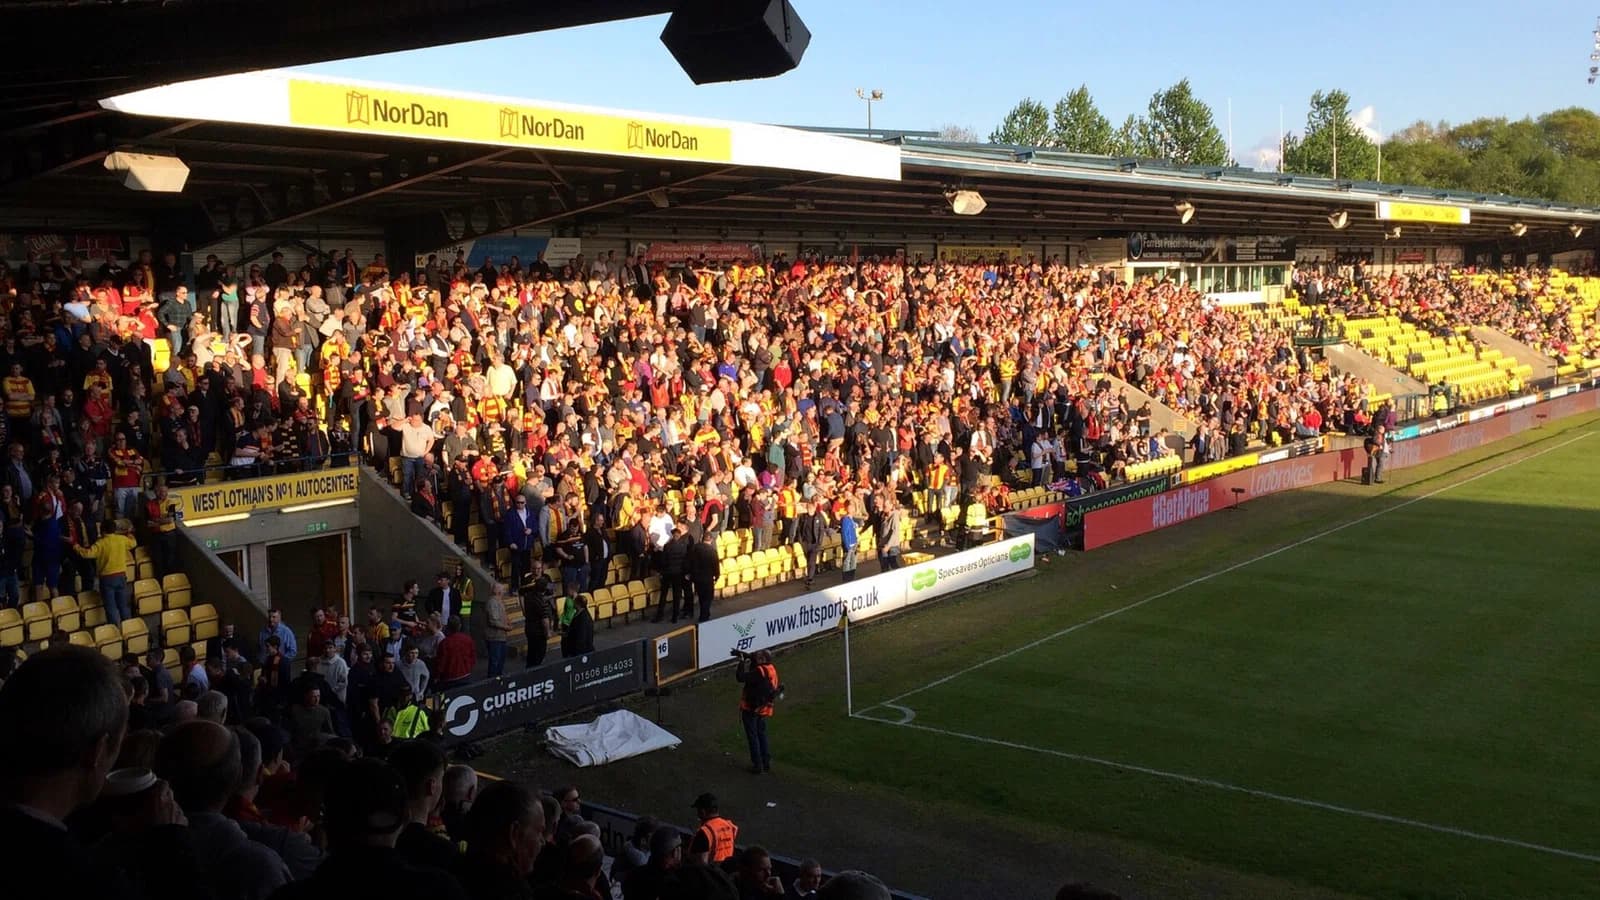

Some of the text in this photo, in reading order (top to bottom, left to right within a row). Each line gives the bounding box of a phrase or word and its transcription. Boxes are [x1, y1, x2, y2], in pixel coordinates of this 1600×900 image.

[373, 99, 449, 128] NorDan
[522, 114, 585, 141] NorDan
[645, 128, 698, 151] NorDan
[1249, 461, 1314, 496] Ladbrokes
[192, 490, 221, 513] WEST
[223, 484, 273, 508] LOTHIAN'S
[296, 474, 355, 498] AUTOCENTRE
[1152, 487, 1209, 528] #GetAPrice
[938, 562, 978, 582] Specsavers
[978, 552, 1009, 570] Opticians
[766, 586, 879, 637] www.fbtsports.co.uk
[658, 642, 667, 654] 16
[736, 635, 756, 651] FBT
[574, 667, 601, 682] 01506
[603, 658, 633, 674] 854033
[482, 679, 555, 712] CURRIE'S
